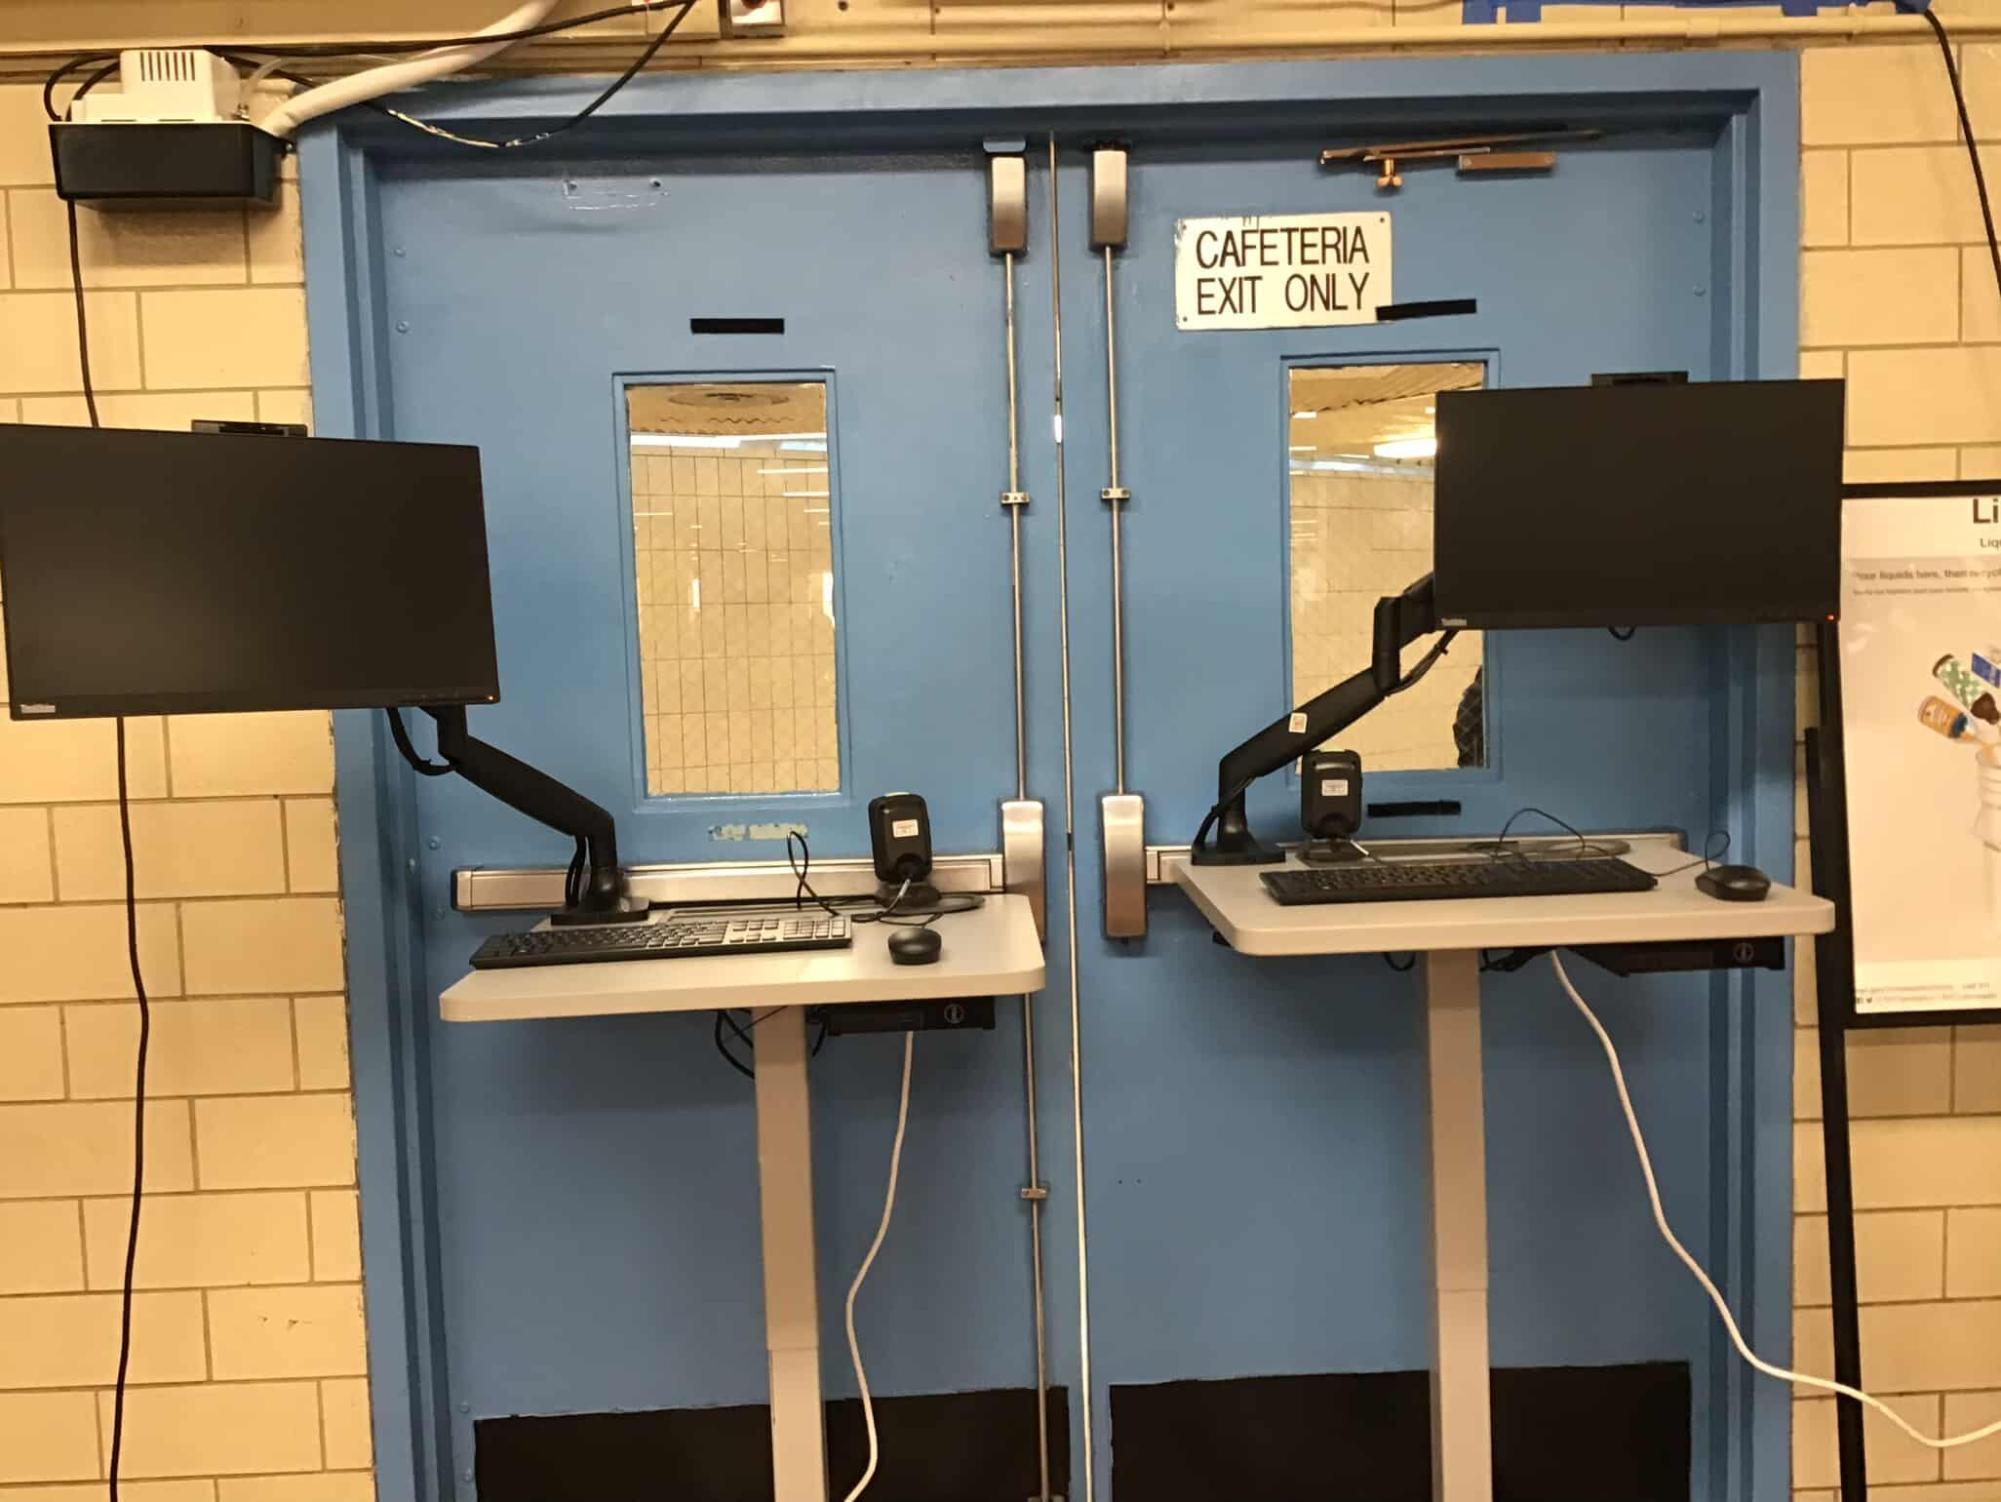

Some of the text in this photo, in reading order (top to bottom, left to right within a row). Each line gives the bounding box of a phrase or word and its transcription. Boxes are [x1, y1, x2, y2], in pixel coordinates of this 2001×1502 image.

[1196, 226, 1369, 269] CAFETERIA
[1197, 272, 1370, 315] EXIT ONLY
